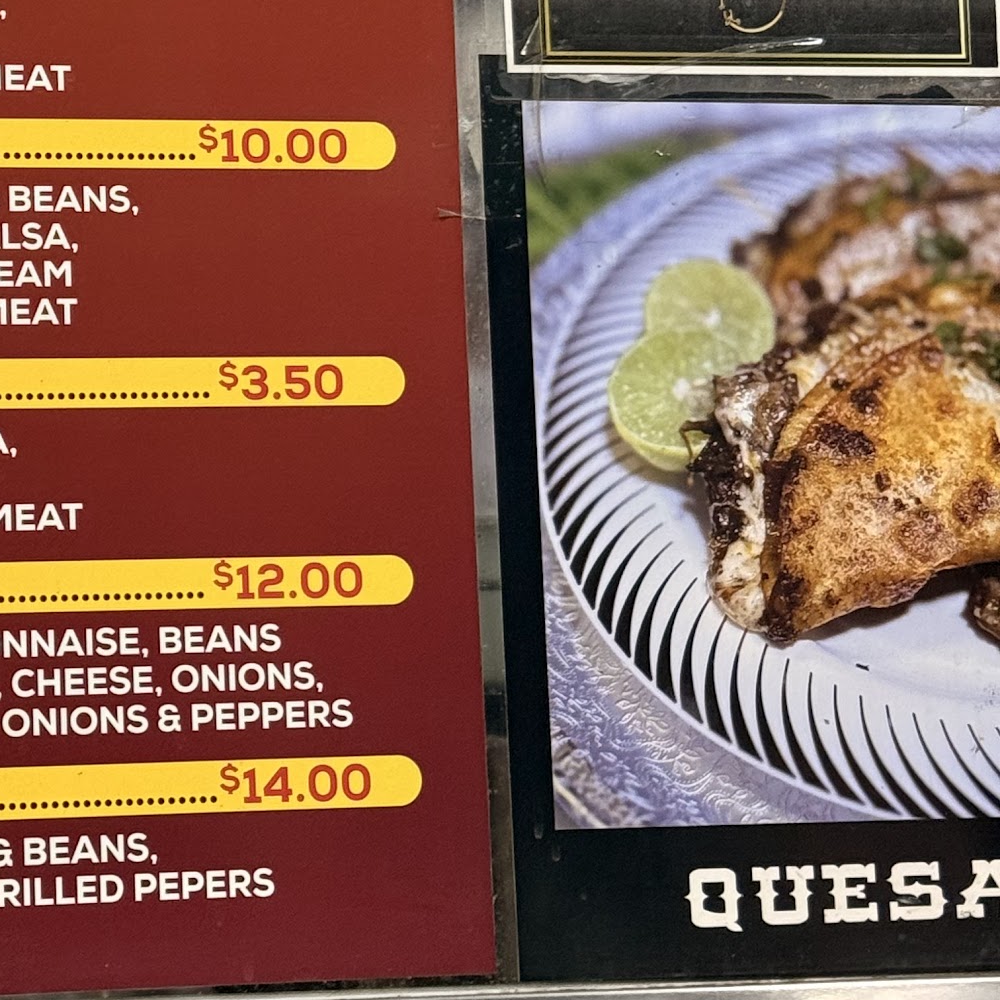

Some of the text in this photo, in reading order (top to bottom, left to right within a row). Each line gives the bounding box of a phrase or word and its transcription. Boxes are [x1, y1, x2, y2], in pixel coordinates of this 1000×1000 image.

[199, 124, 347, 163] $10.00
[9, 185, 138, 215] BEANS,
[219, 361, 343, 400] $3.50
[214, 560, 362, 599] $12.00
[159, 624, 281, 653] BEANS
[12, 666, 162, 697] CHEESE,
[172, 661, 323, 692] ONIONS,
[2, 705, 148, 737] ONIONS
[158, 704, 181, 732] &
[192, 699, 353, 731] PEPPERS
[220, 763, 371, 803] $14.00
[24, 833, 157, 865] BEANS,
[135, 868, 274, 901] PEPERS
